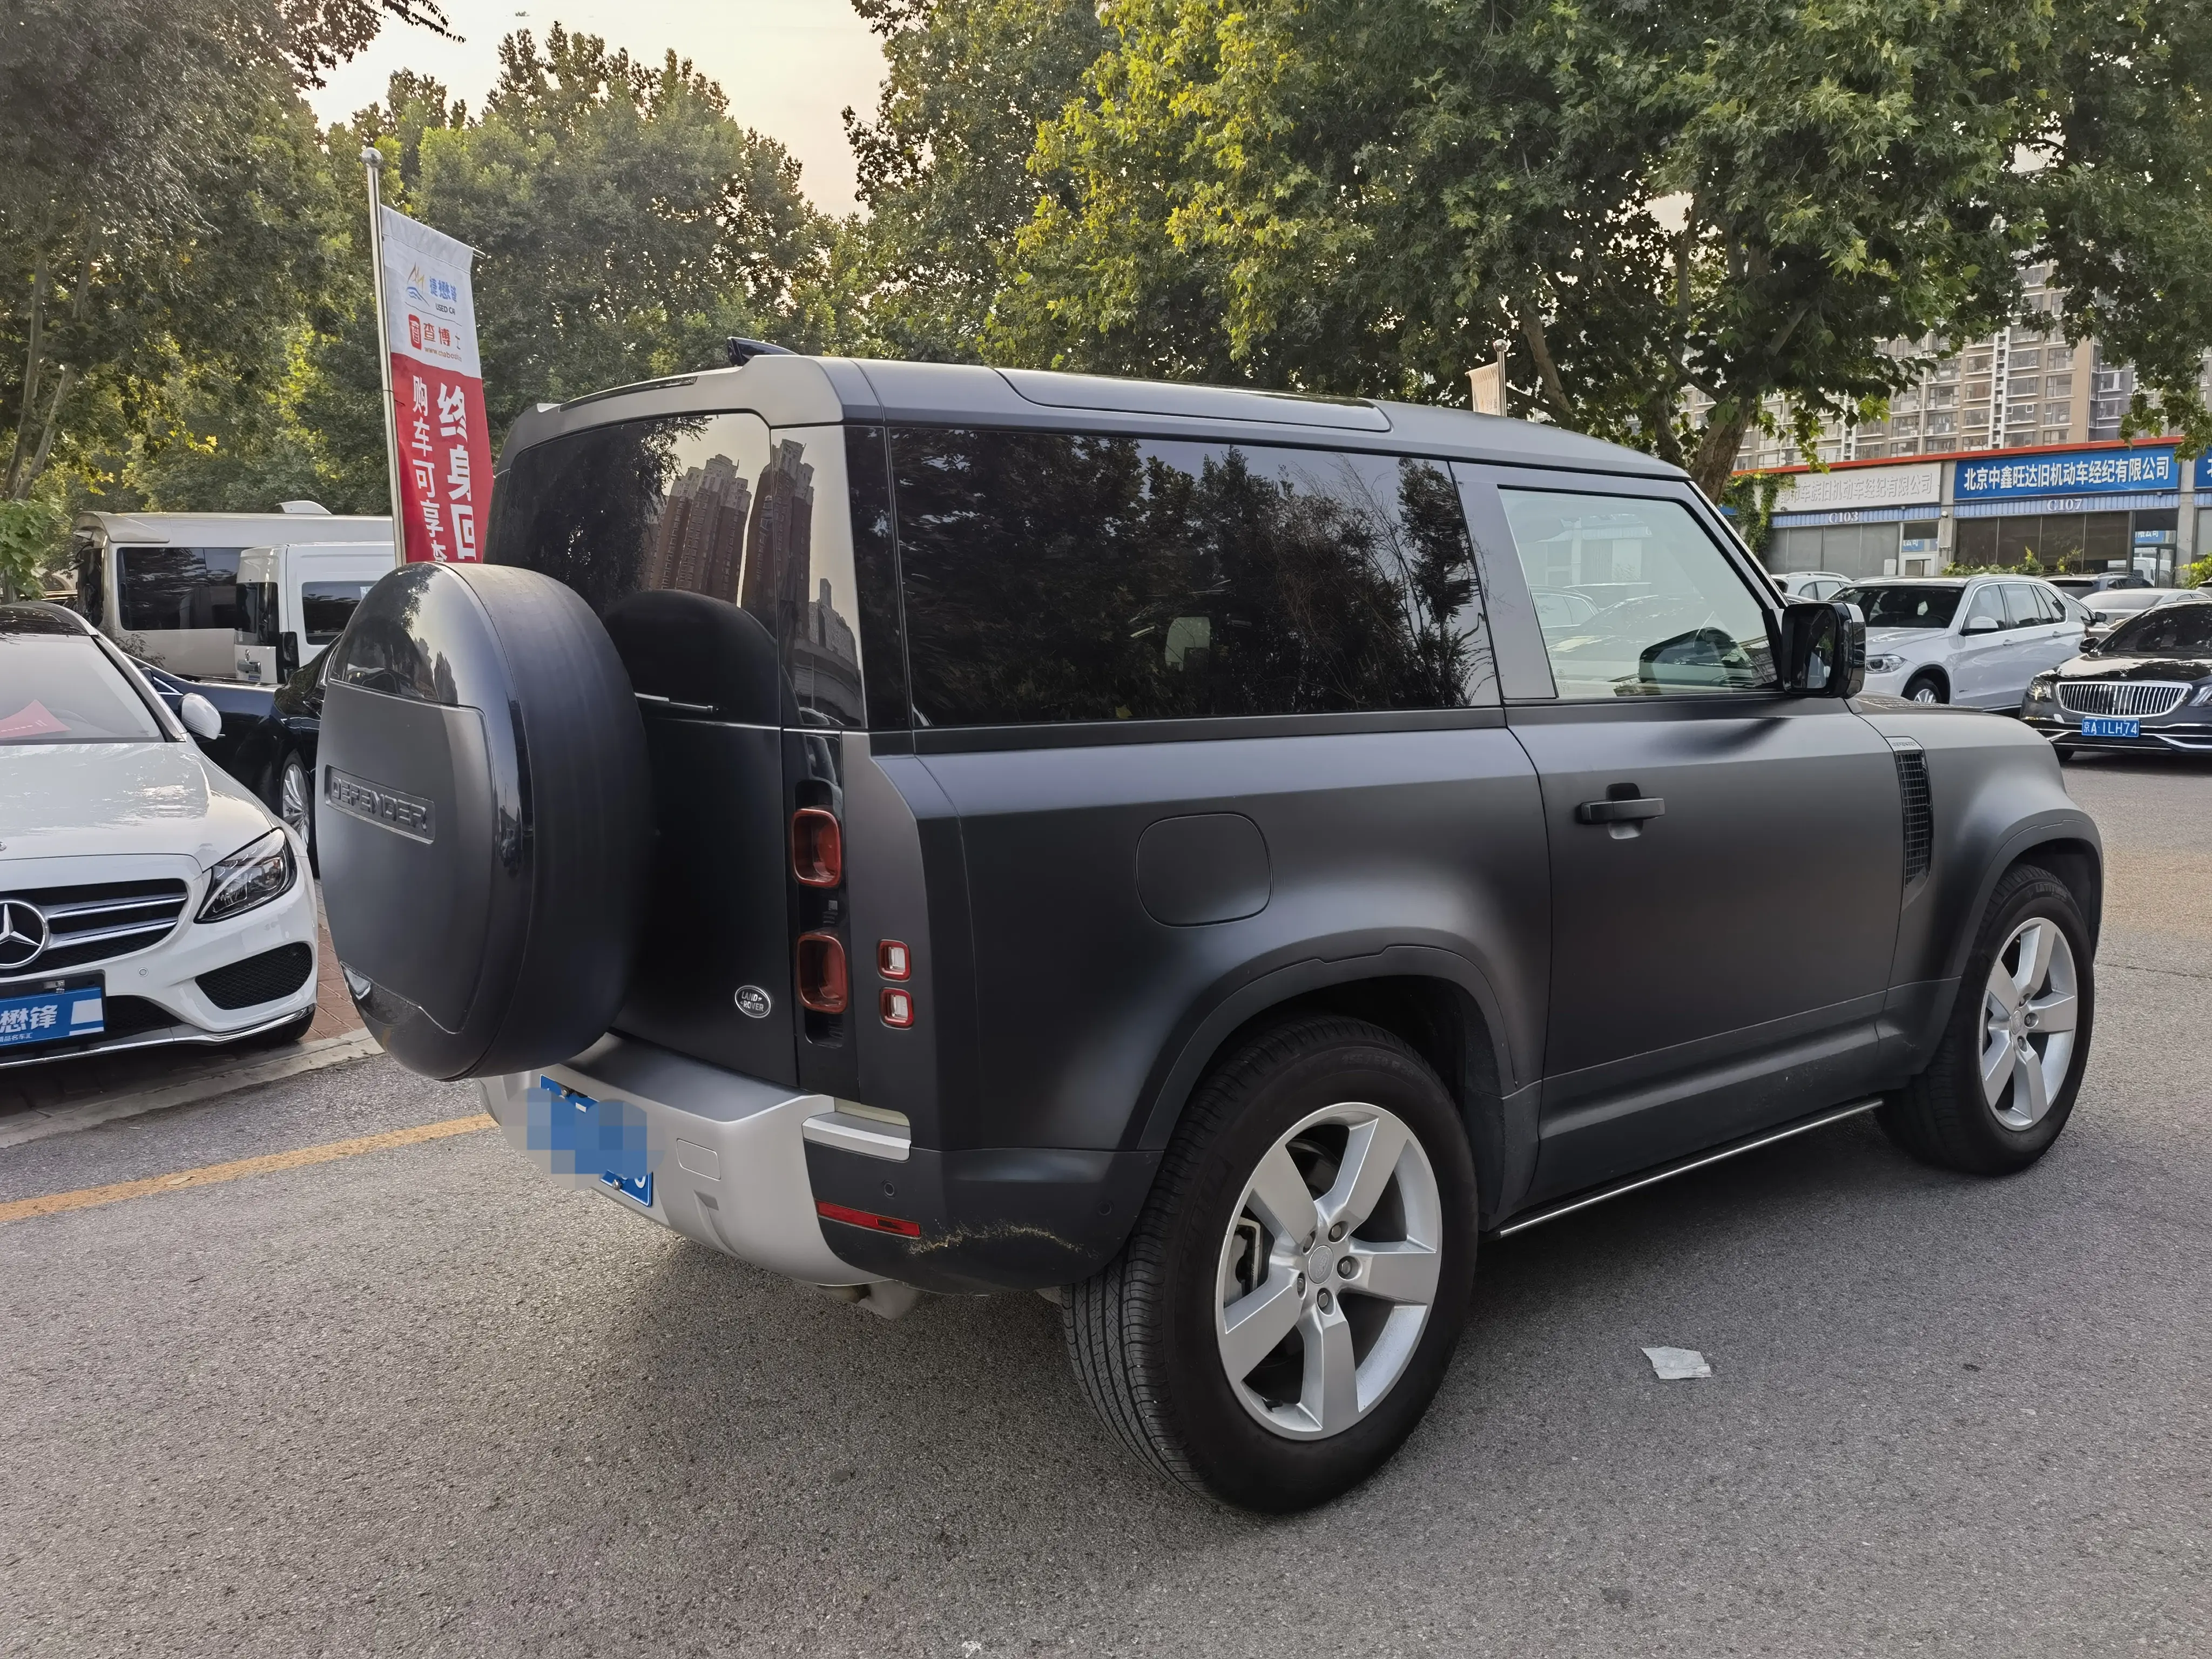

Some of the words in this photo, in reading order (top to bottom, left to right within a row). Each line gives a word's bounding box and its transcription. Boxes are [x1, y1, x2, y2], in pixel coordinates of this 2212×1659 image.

[435, 303, 448, 313] USED
[1964, 456, 2169, 491] 北京中鑫旺达旧机动车经纪有限公司
[2047, 498, 2082, 512] C107
[1829, 511, 1859, 524] C103
[332, 776, 427, 832] DEFENDER
[741, 991, 758, 1001] LAND
[743, 1000, 764, 1011] ROVER
[0, 1005, 58, 1033] 懋锋
